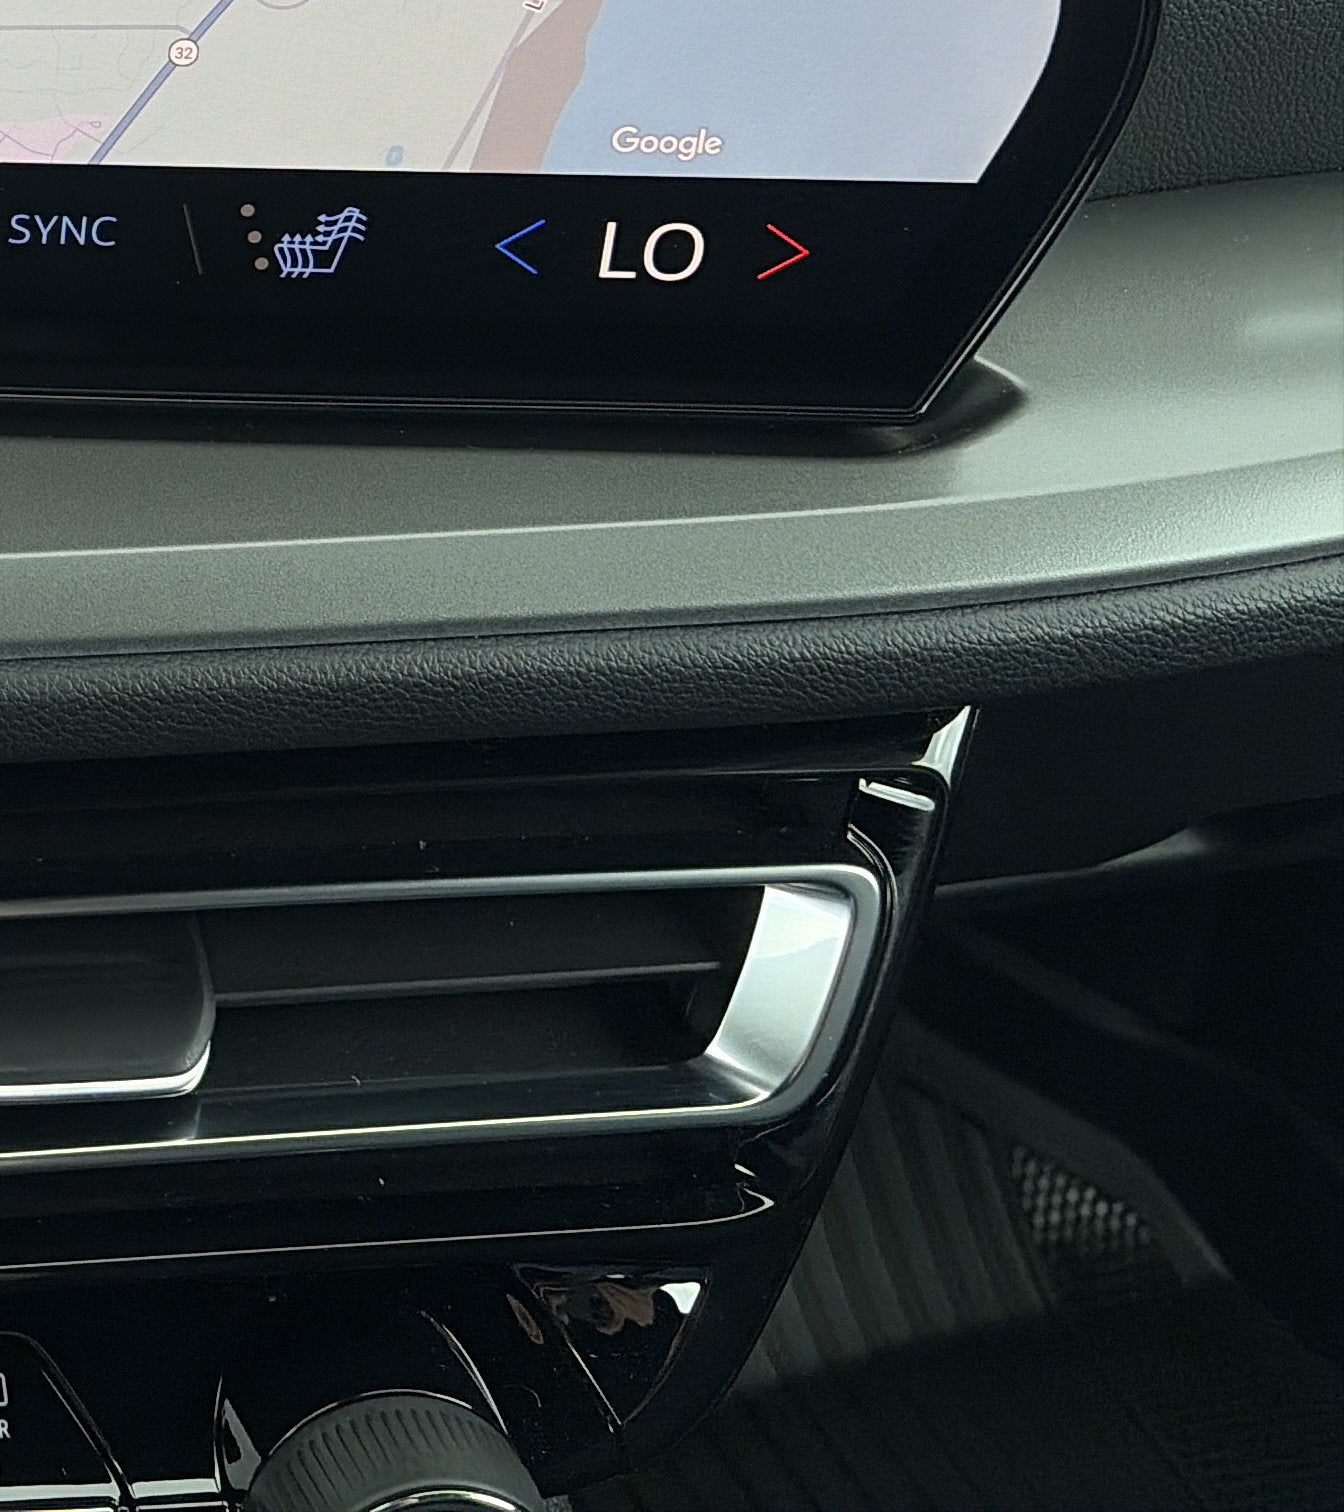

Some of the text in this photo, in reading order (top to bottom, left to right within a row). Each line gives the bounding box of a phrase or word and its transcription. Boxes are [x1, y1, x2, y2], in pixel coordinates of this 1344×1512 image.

[174, 47, 193, 60] 32
[611, 126, 723, 162] Google
[8, 214, 118, 247] SYNC
[598, 222, 706, 281] LO
